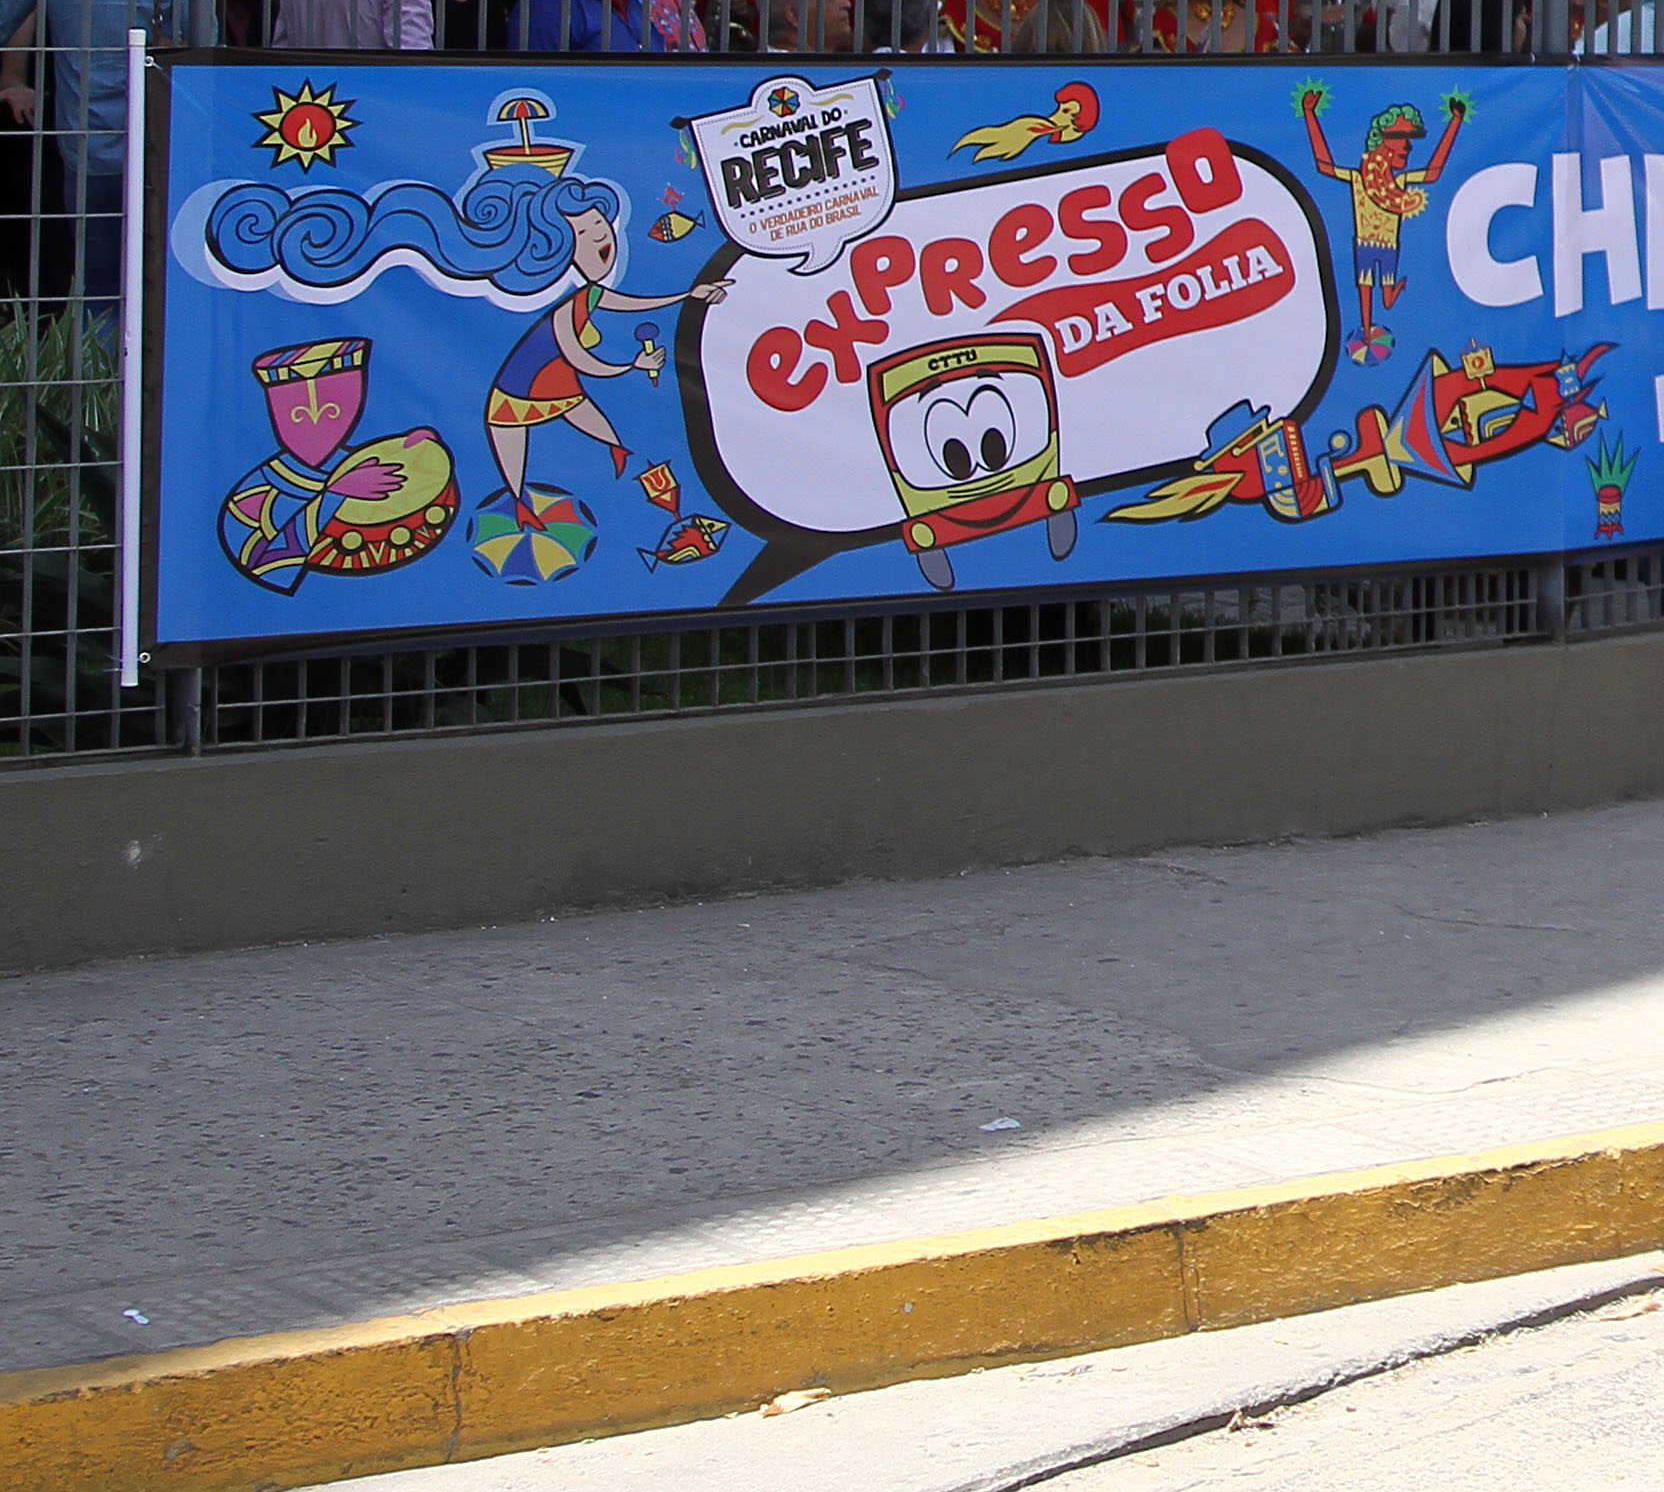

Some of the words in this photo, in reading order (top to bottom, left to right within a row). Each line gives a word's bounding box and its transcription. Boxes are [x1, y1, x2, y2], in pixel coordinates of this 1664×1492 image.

[740, 115, 818, 148] CARNAVAL
[822, 108, 842, 126] DO
[720, 118, 880, 208] RECIFE
[749, 222, 757, 234] O
[760, 202, 823, 230] VERDADEIRO
[824, 186, 880, 210] CARNAVAL
[770, 229, 784, 241] DE
[786, 222, 808, 237] RUA
[809, 216, 824, 229] DO
[826, 205, 862, 225] BRASIL
[1055, 302, 1132, 354] DA
[1136, 244, 1283, 324] FOLIA
[928, 347, 977, 371] CTTU
